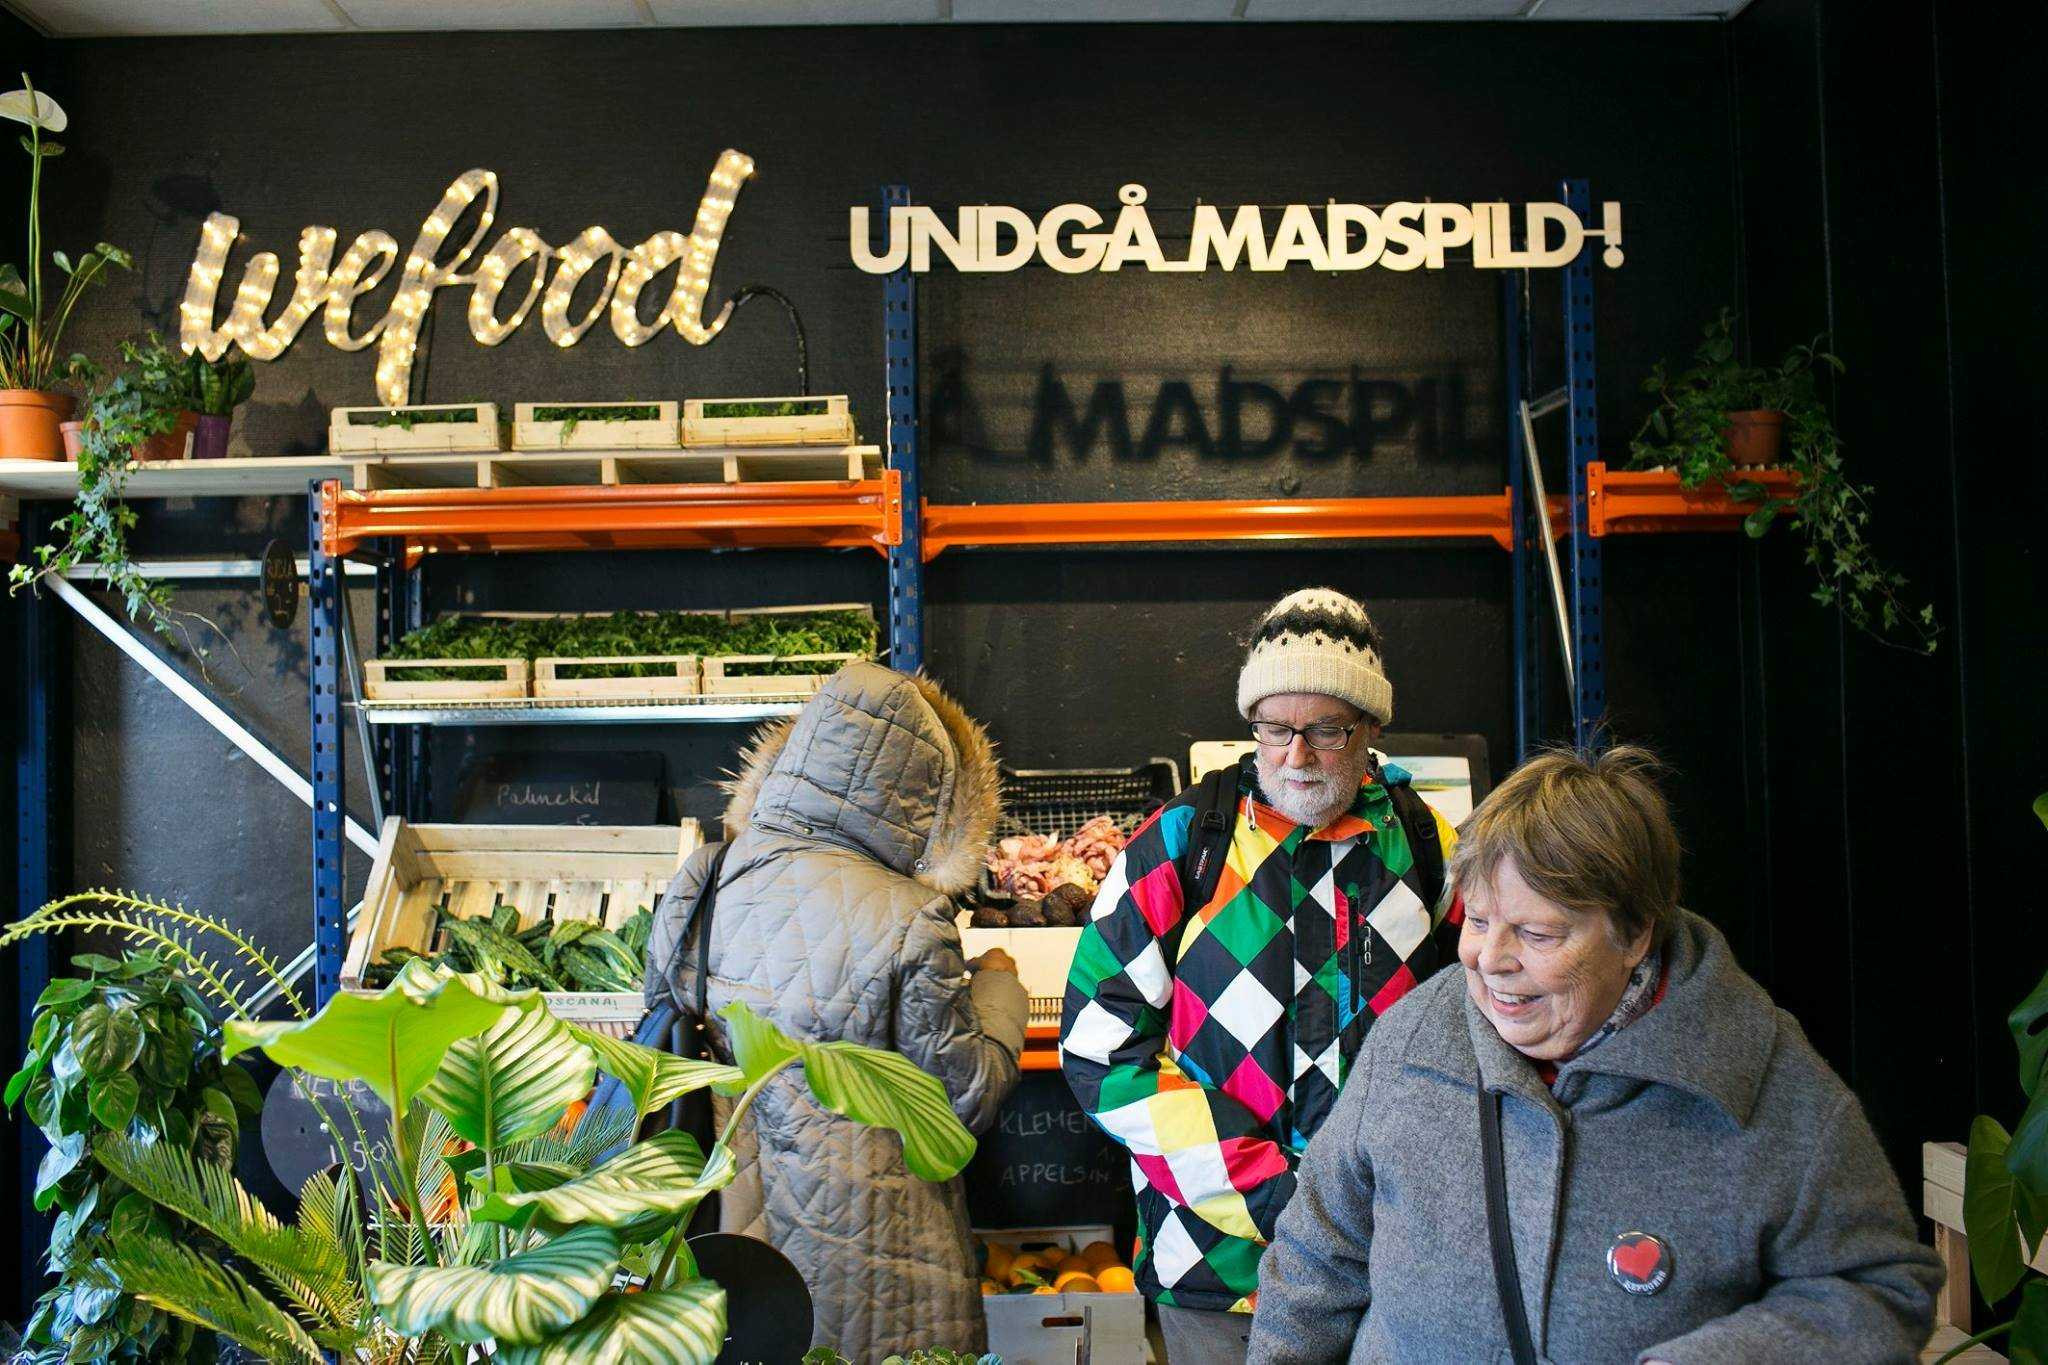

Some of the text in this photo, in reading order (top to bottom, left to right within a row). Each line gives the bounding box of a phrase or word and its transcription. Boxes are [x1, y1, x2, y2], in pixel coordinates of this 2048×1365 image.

[849, 183, 1166, 274] UNDGÅ
[179, 149, 756, 407] wefood
[999, 1109, 1089, 1136] KLEME
